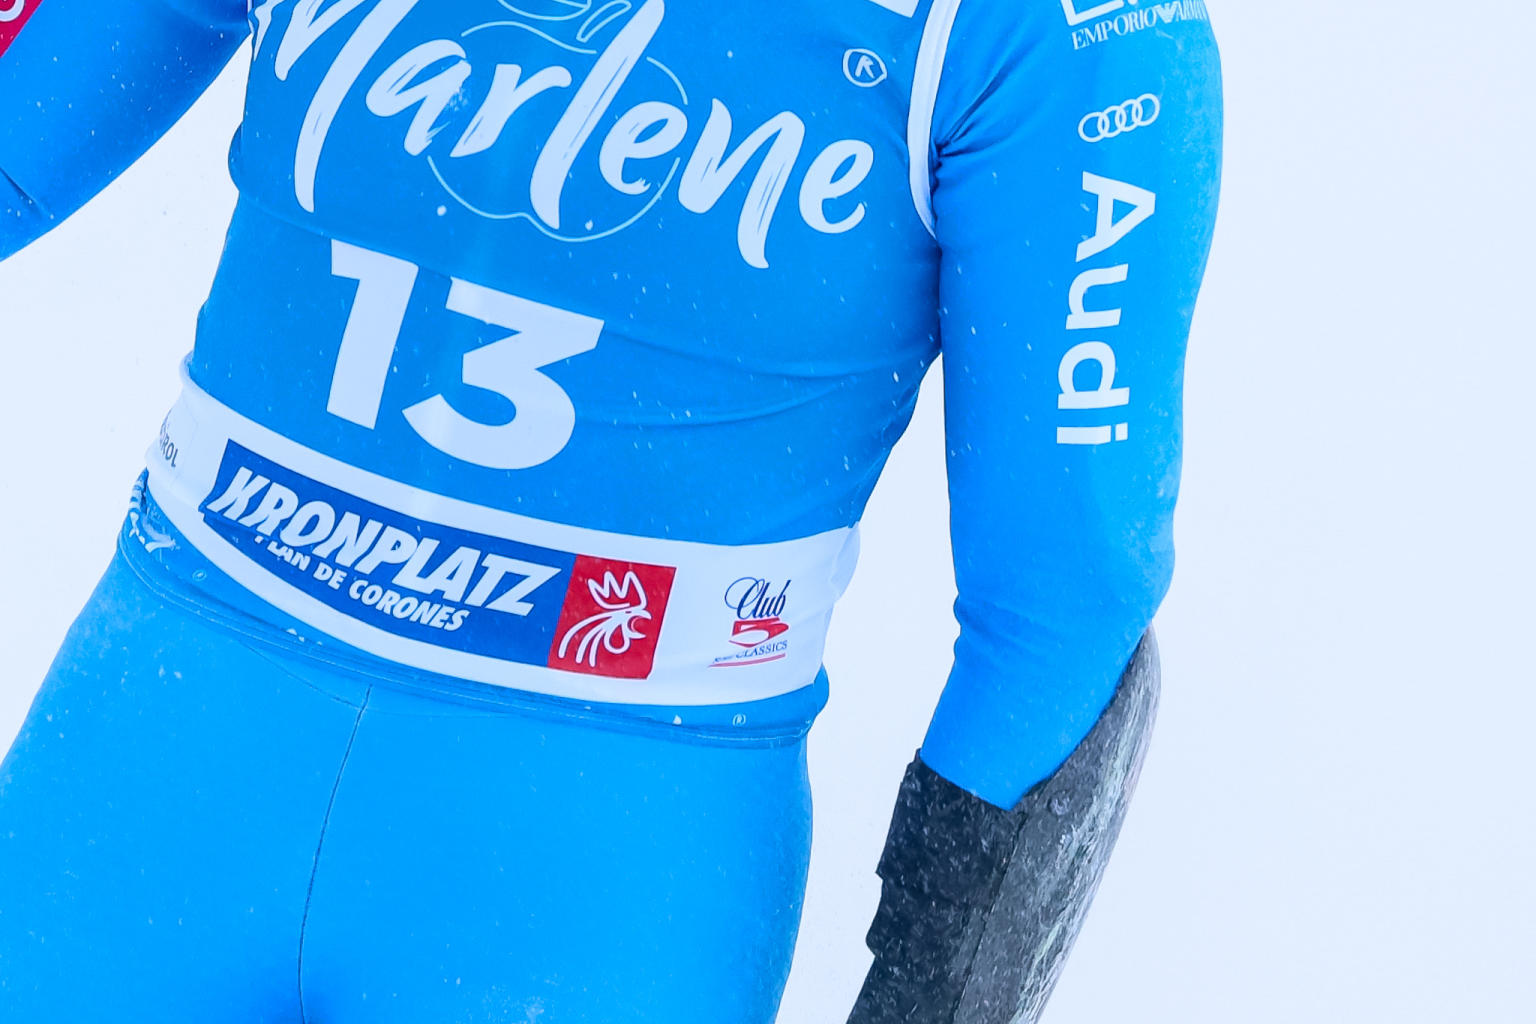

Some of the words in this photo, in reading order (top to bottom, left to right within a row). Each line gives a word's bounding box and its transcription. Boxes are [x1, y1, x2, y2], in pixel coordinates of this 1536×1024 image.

[1071, 7, 1157, 50] EMPORIO
[326, 238, 605, 470] 13
[1056, 171, 1156, 445] Audi
[206, 466, 562, 616] KRONPLATZ
[254, 536, 311, 571] LAN
[312, 562, 347, 590] DE
[349, 580, 470, 631] CORONES
[725, 577, 791, 620] Club
[728, 617, 789, 648] 5
